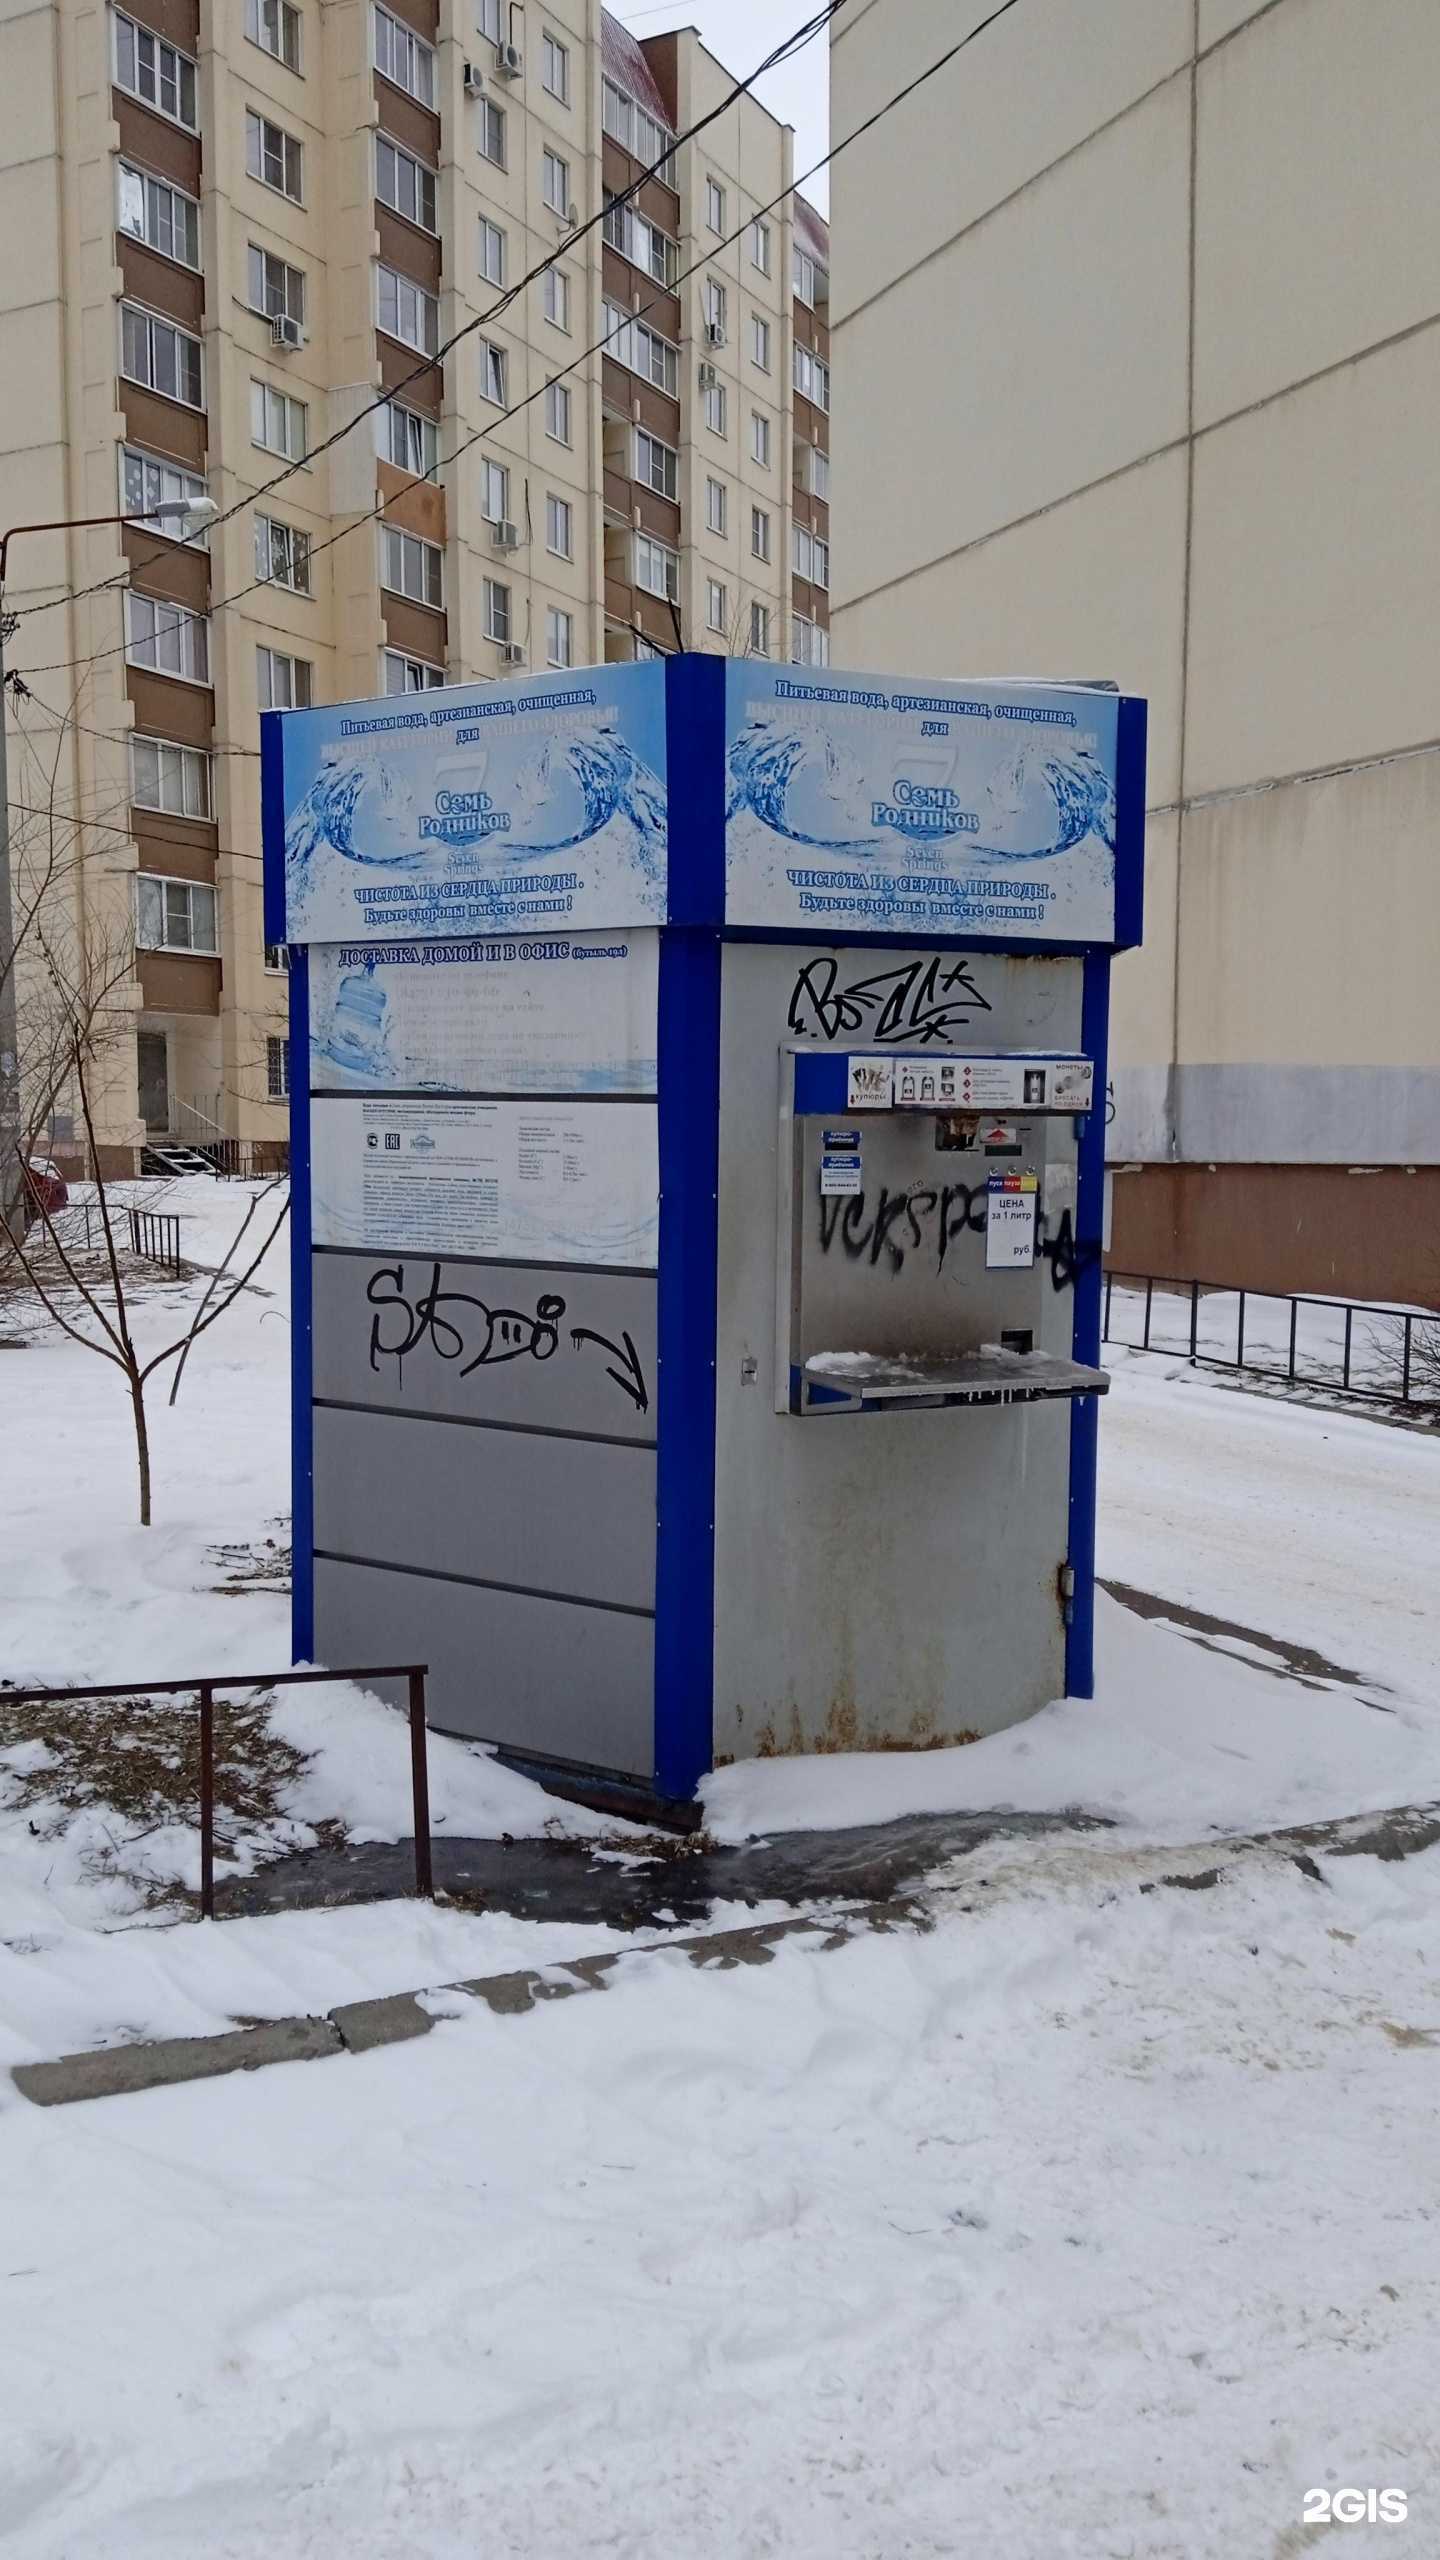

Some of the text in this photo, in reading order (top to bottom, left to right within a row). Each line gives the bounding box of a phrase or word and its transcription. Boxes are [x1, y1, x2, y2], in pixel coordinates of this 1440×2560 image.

[340, 689, 596, 735] Питьевая вода, артезианская, очищенная,
[775, 680, 1077, 726] Питьевая вода, артезианская, очищенная,
[456, 728, 480, 745] для
[921, 720, 949, 736] для
[436, 791, 493, 815] Семь
[893, 780, 960, 808] Семь
[418, 813, 511, 839] Родников
[871, 802, 980, 834] Родников
[354, 886, 418, 902] ЧИСТОТА
[419, 884, 440, 899] ИЗ
[441, 880, 500, 899] СЕРДЦА
[787, 869, 869, 889] ЧИСТОТА
[870, 876, 894, 892] ИЗ
[896, 876, 966, 896] СЕРДЦА
[364, 908, 407, 924] Будьте
[409, 906, 465, 923] здоровы
[469, 903, 515, 917] вместе
[517, 902, 526, 913] с
[800, 893, 855, 912] Будьте
[857, 899, 925, 916] здоровы
[931, 902, 983, 917] вместе
[985, 905, 994, 917] с
[339, 946, 420, 967] ДОСТАВКА
[421, 942, 484, 965] ДОМОЙ
[485, 943, 501, 961] И
[503, 943, 517, 961] В
[518, 941, 570, 960] ОФИС
[999, 1199, 1025, 1209] ЦЕНА
[991, 1212, 1001, 1220] за
[1010, 1212, 1032, 1222] литр
[1013, 1245, 1032, 1256] руб.
